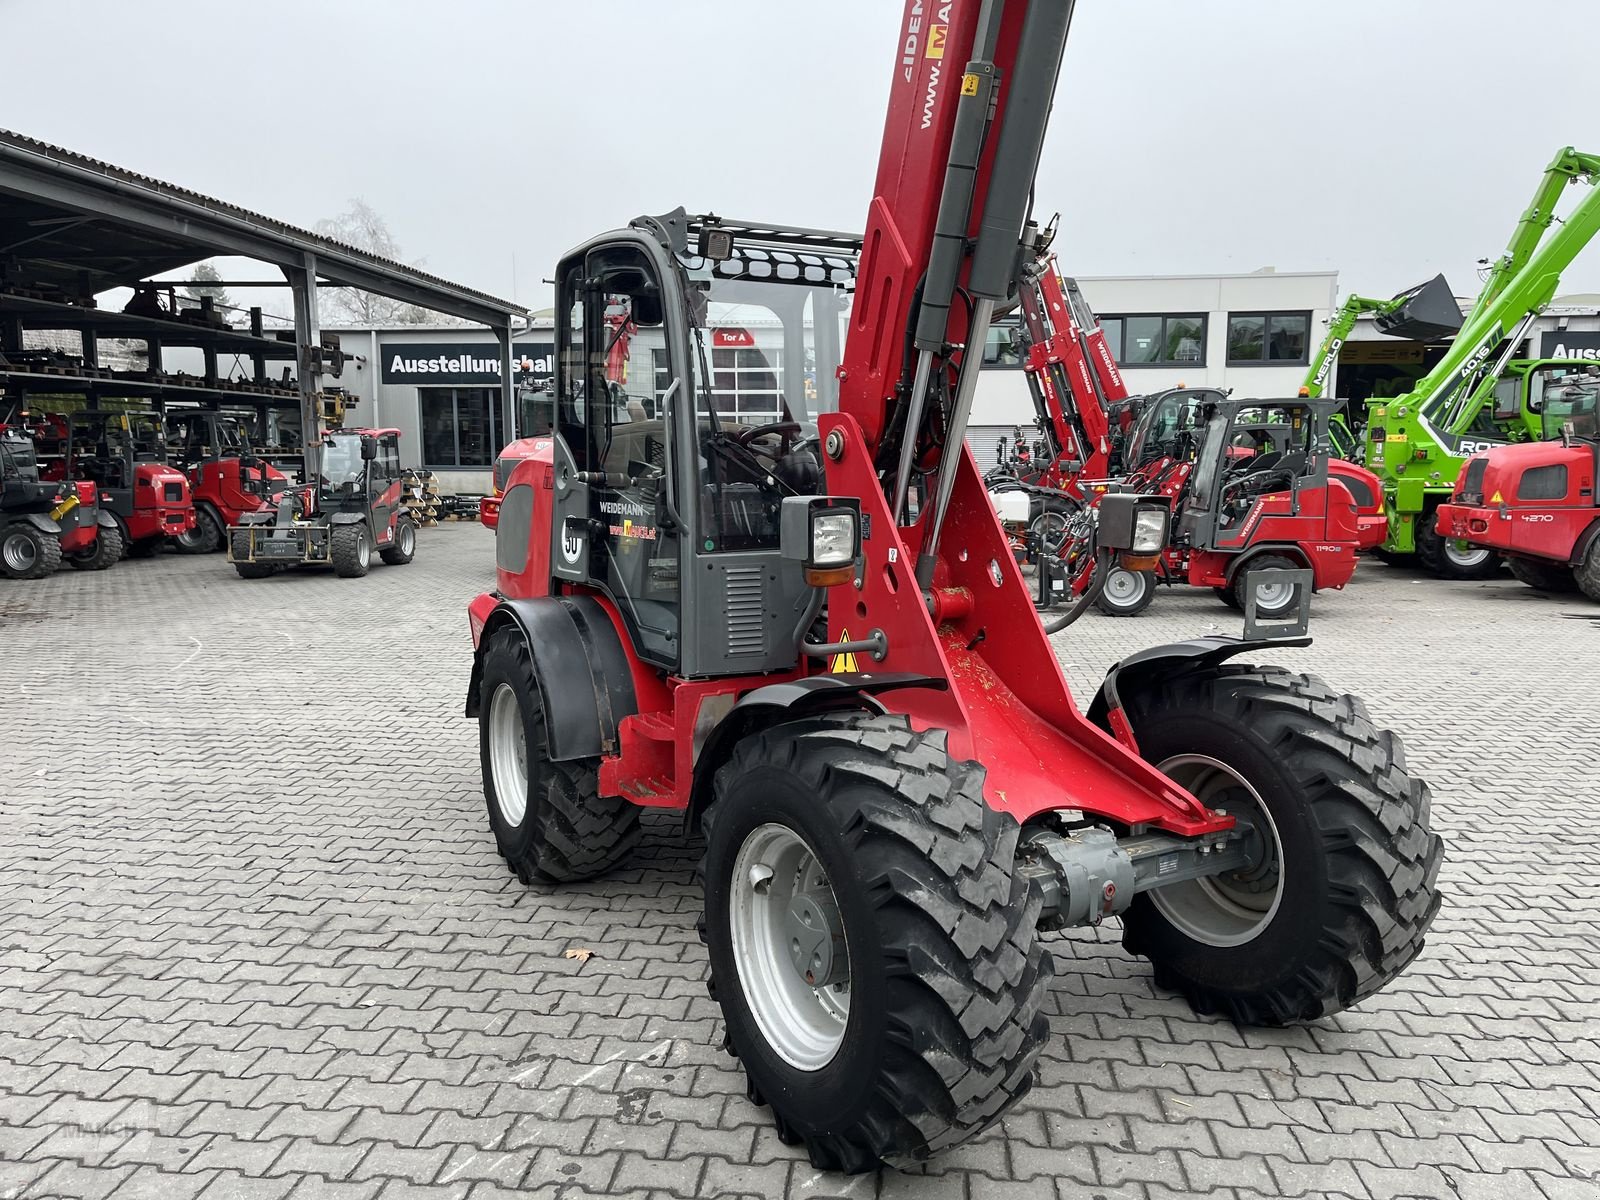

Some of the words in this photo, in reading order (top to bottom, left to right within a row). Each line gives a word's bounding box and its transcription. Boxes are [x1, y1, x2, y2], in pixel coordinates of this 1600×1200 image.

[722, 333, 736, 342] Tor
[738, 333, 746, 342] A
[1078, 359, 1093, 394] WEIDEMANN
[1097, 340, 1121, 388] WEIDEMANN
[1313, 339, 1342, 385] MERLO
[1461, 345, 1490, 378] 40.16
[599, 501, 644, 516] WEIDEMANN
[1240, 501, 1265, 537] WEIDEMANN
[1521, 514, 1554, 522] 4270
